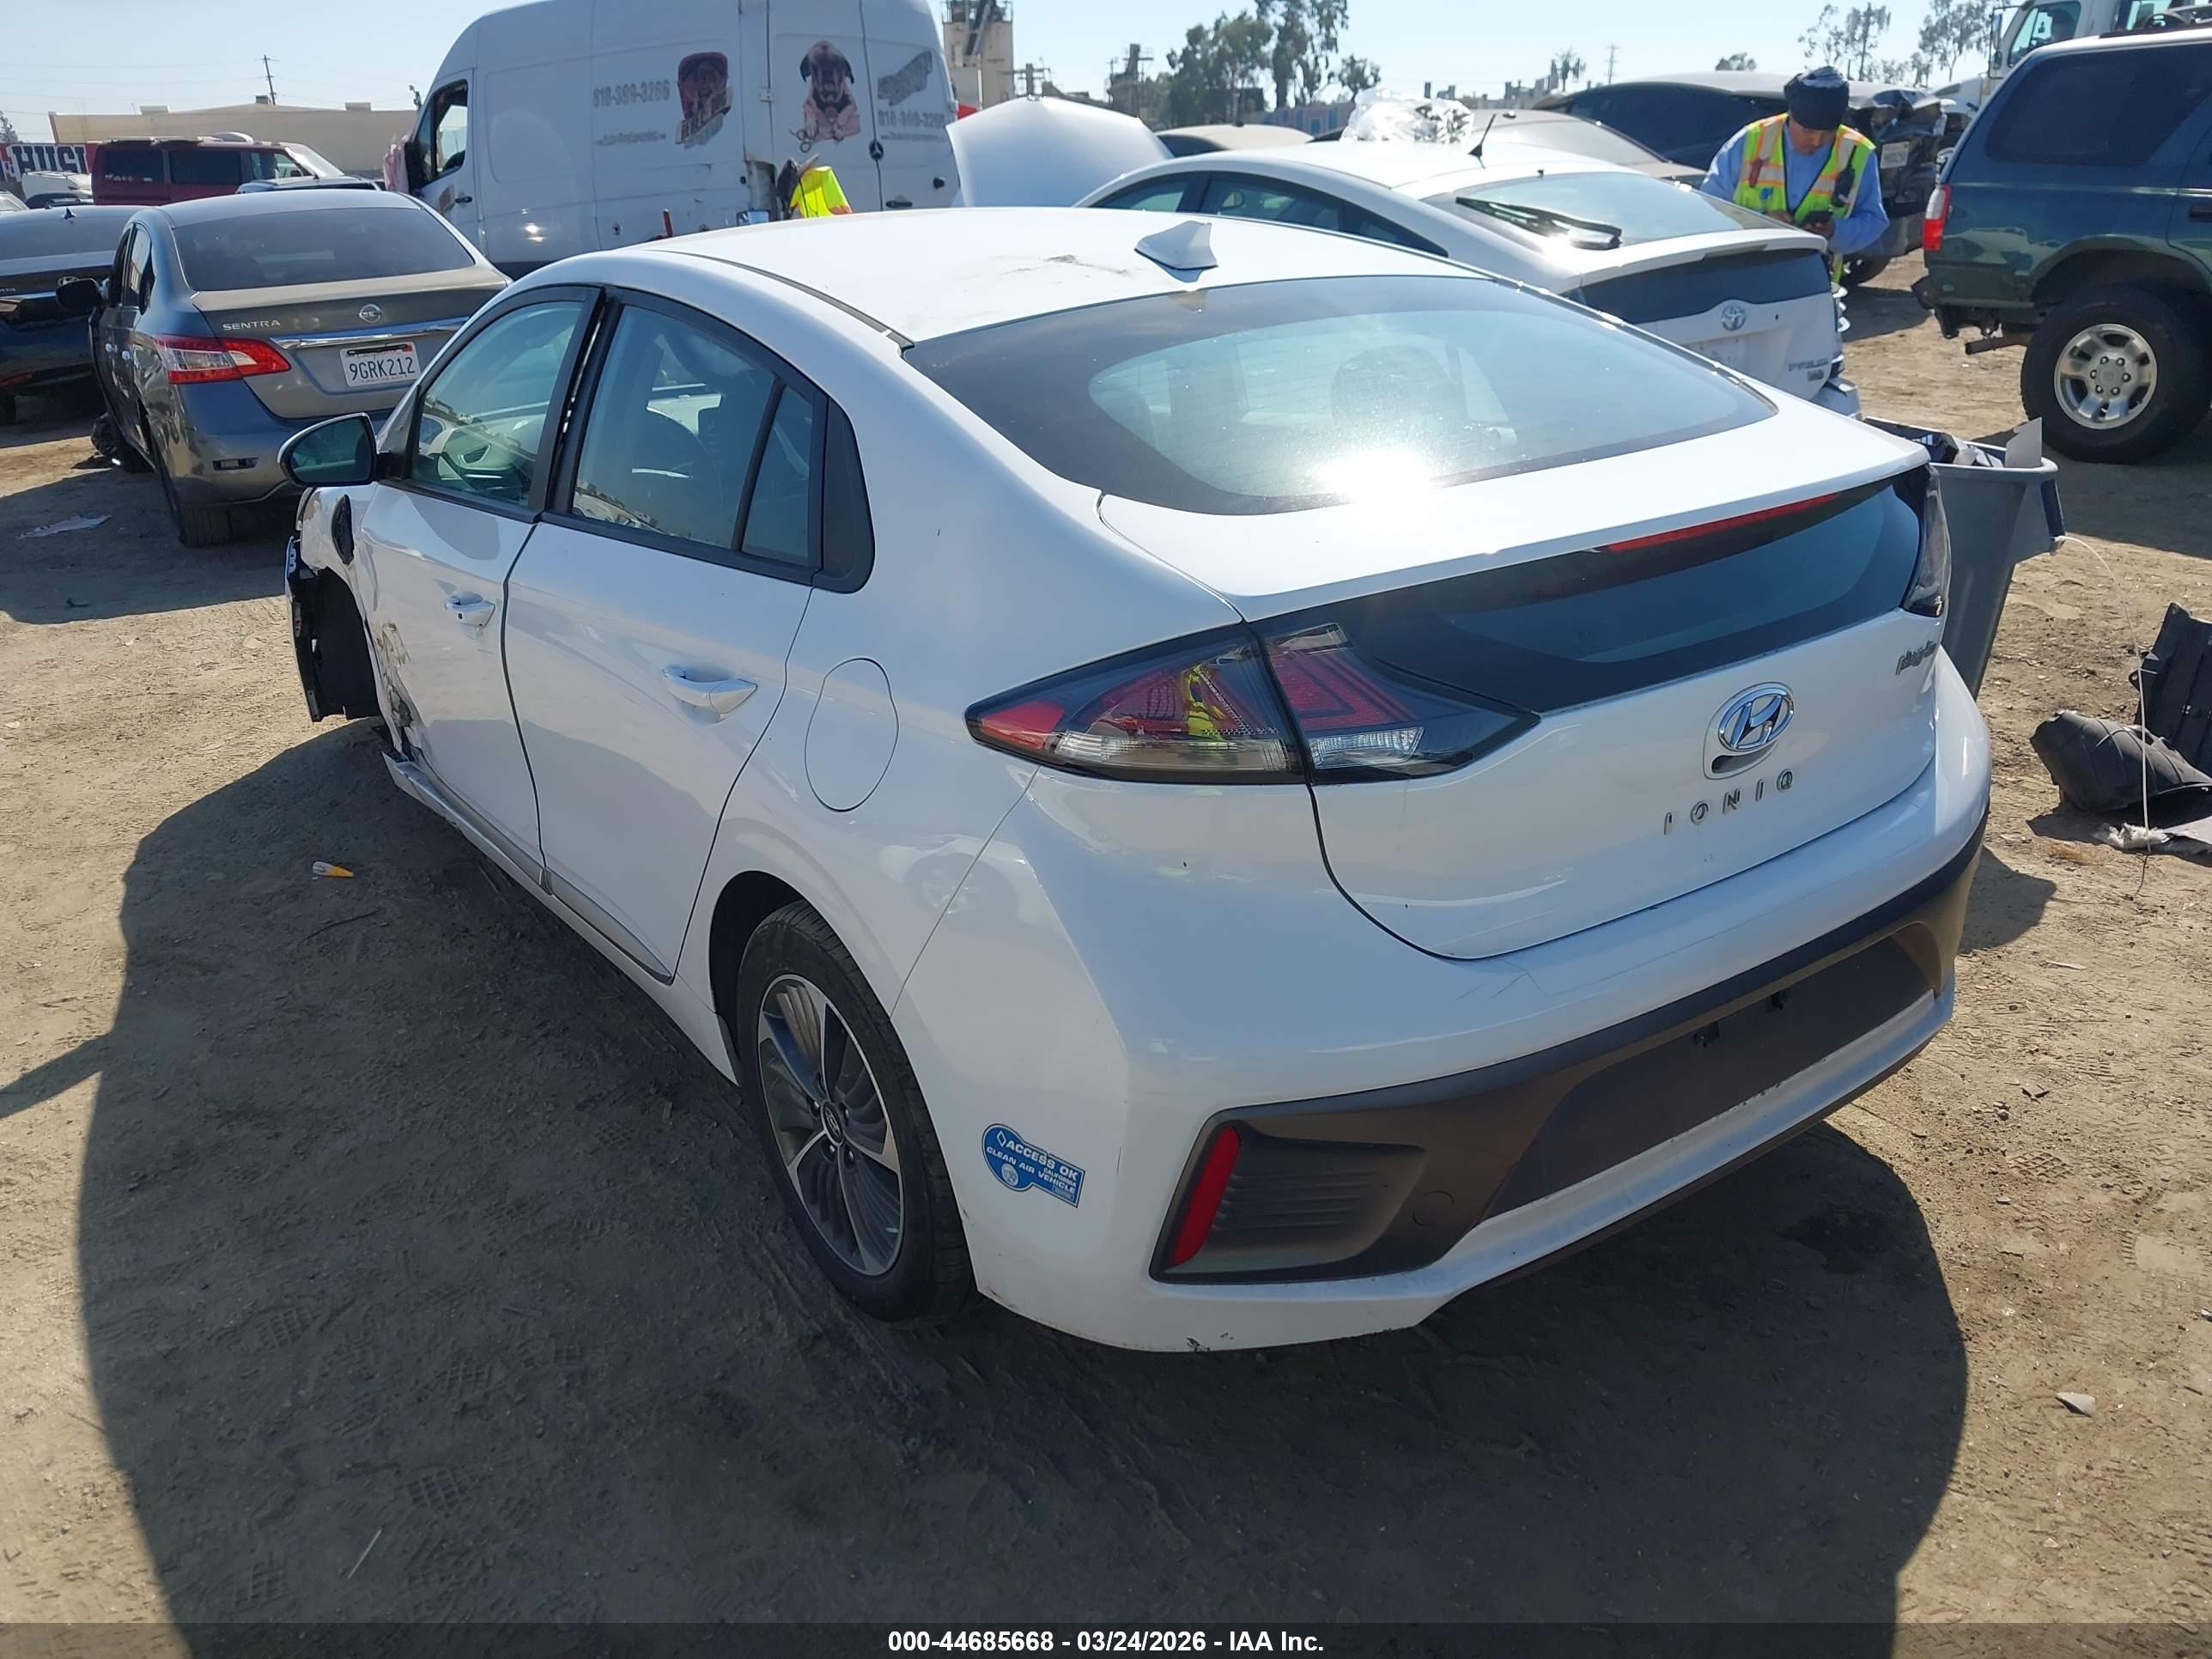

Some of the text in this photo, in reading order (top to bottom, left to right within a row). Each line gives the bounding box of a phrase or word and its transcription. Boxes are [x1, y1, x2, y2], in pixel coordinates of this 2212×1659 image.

[222, 319, 281, 331] SENTRA
[349, 356, 415, 380] 9GRK212
[1664, 769, 1793, 836] IONIQ
[987, 1146, 1017, 1165] CLEAN
[1018, 1163, 1036, 1175] AIR
[1038, 1170, 1076, 1194] VEHICLE
[1006, 1139, 1079, 1181] ACCESS OK
